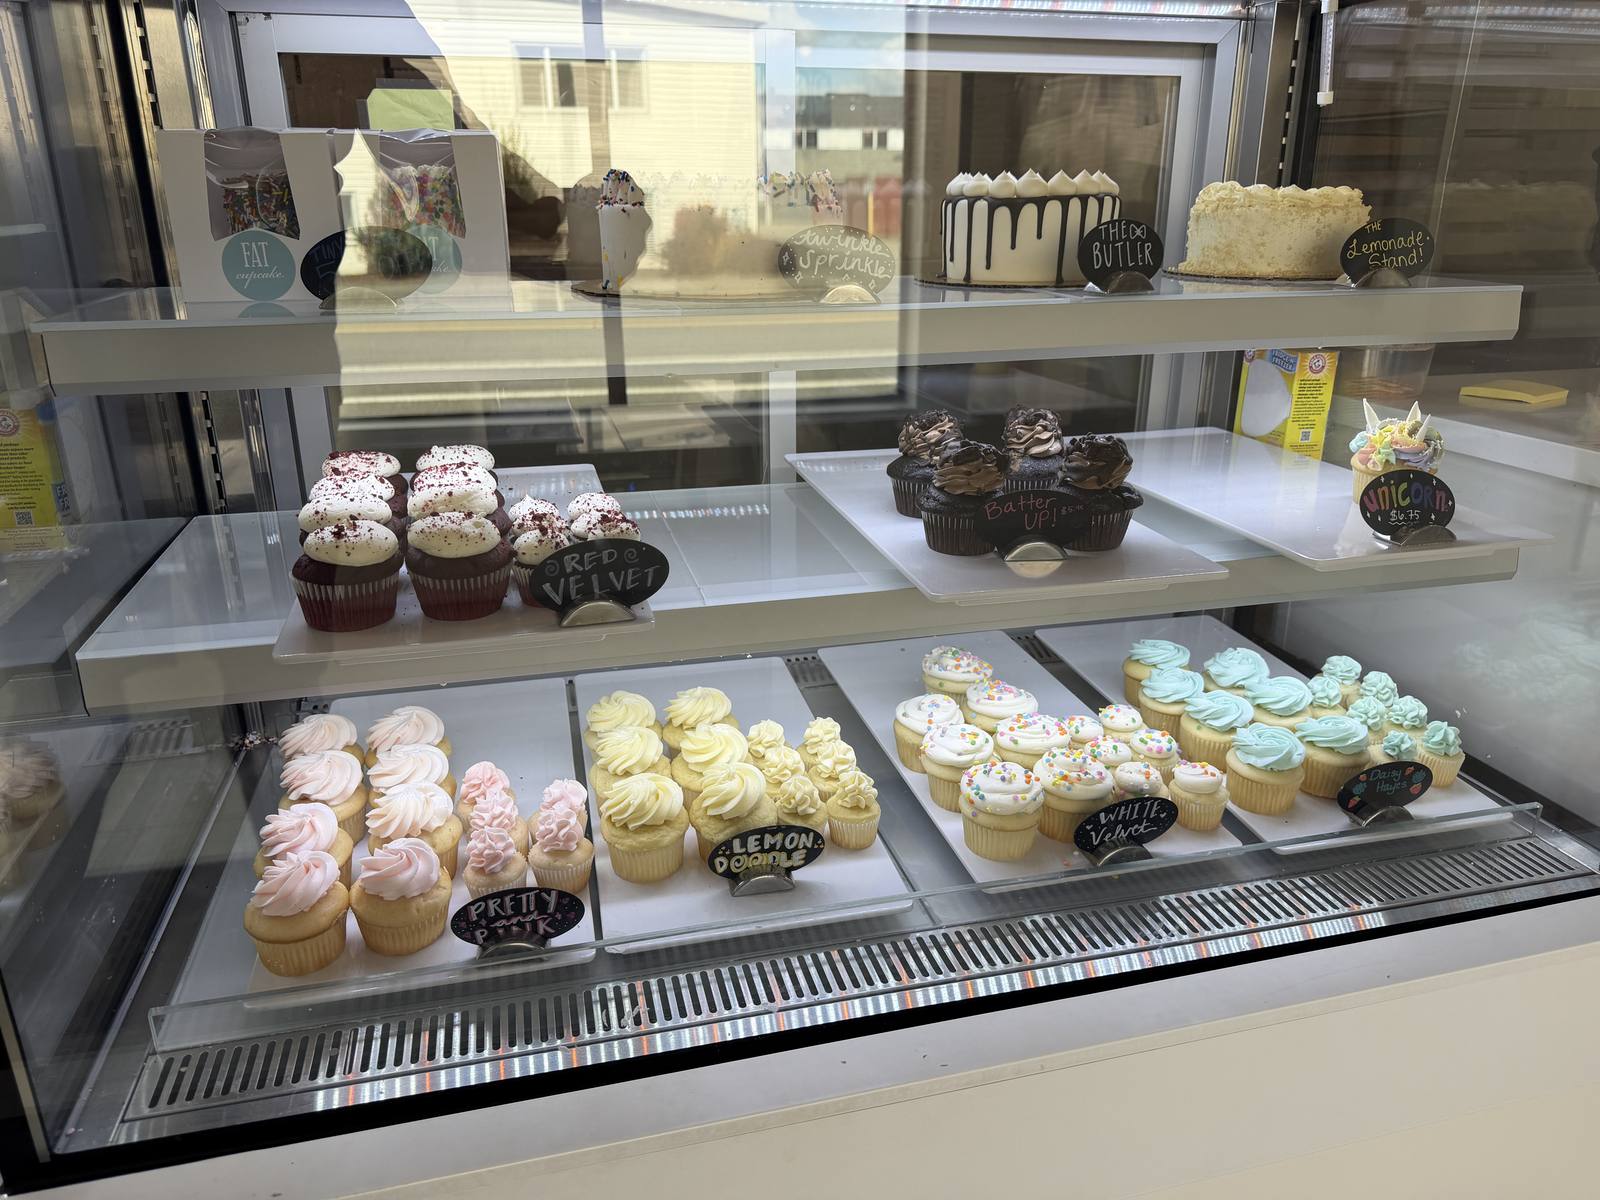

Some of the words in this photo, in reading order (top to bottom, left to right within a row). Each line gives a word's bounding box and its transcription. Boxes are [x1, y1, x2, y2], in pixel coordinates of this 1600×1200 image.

[1099, 221, 1127, 241] THE
[1365, 220, 1382, 233] THE
[240, 242, 269, 267] FAT
[800, 249, 891, 279] Sprinkle
[1093, 241, 1153, 269] BUTLER
[1369, 248, 1423, 268] Stand!
[984, 494, 1056, 520] Batter
[1025, 508, 1057, 530] UP!
[1390, 510, 1421, 520] $6.75
[564, 549, 617, 573] RED
[542, 565, 660, 606] VELVET
[1099, 800, 1162, 824] WHITE
[732, 832, 814, 854] LEMON
[1090, 819, 1158, 845] Velvet
[467, 890, 559, 921] PRETTY
